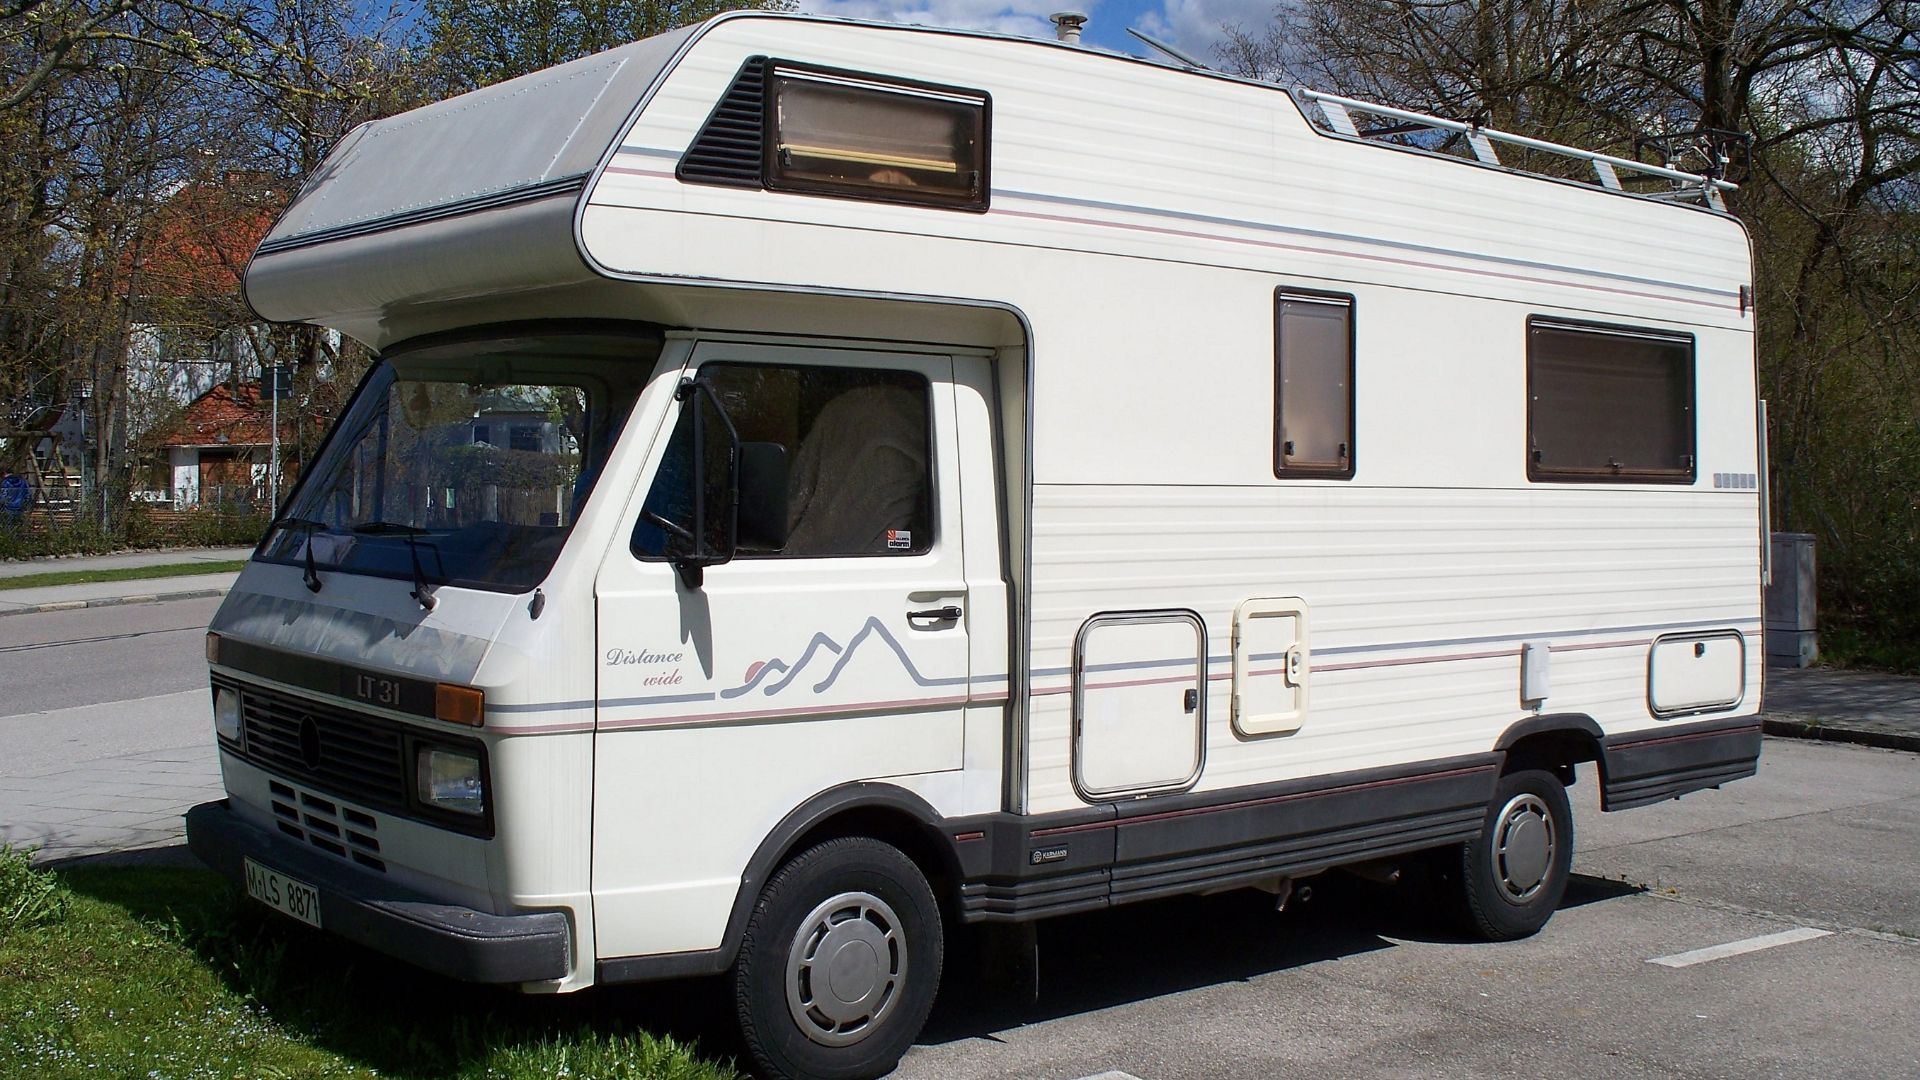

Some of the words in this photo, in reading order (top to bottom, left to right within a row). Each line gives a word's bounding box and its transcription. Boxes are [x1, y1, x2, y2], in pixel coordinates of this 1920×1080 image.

[606, 648, 683, 666] Distance
[357, 674, 376, 699] LT
[379, 680, 399, 705] 31
[643, 668, 683, 687] wide
[287, 882, 319, 924] 8871
